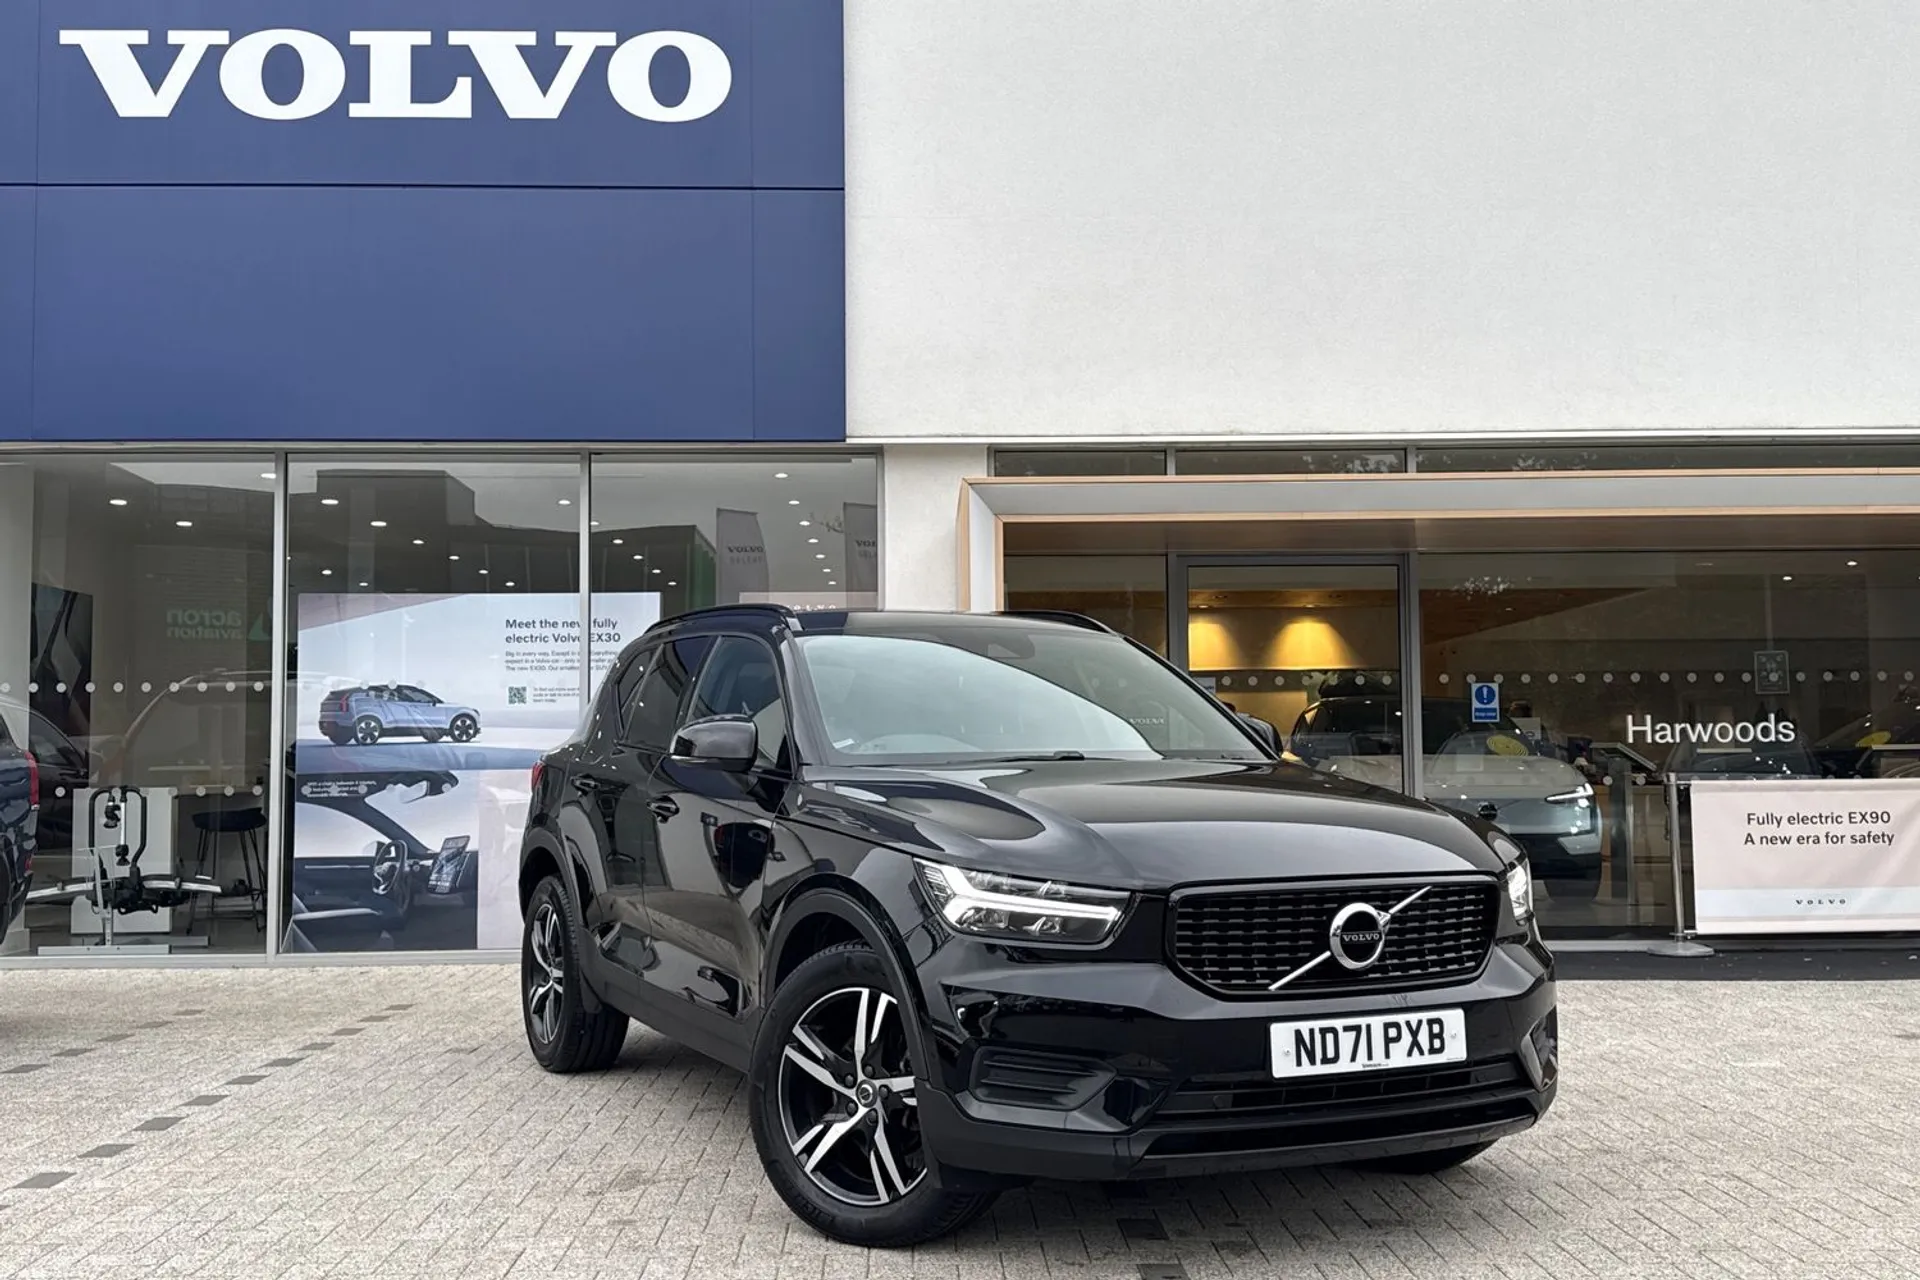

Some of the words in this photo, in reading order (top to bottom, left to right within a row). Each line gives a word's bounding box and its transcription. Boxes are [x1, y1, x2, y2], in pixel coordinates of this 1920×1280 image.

[59, 28, 733, 123] VOLVO
[505, 619, 536, 629] Meet
[540, 619, 559, 629] the
[593, 618, 618, 630] fully
[505, 633, 549, 644] electric
[1626, 713, 1796, 744] Harwoods
[1747, 812, 1783, 828] Fully
[1787, 812, 1844, 825] electric
[1848, 811, 1891, 824] EX90
[1744, 832, 1755, 846] A
[1760, 834, 1792, 845] new
[1796, 834, 1820, 845] era
[1825, 831, 1846, 845] for
[1850, 831, 1895, 847] safety
[1342, 932, 1381, 942] VOLVO
[1294, 1022, 1374, 1068] ND71
[1383, 1017, 1446, 1060] PXB
